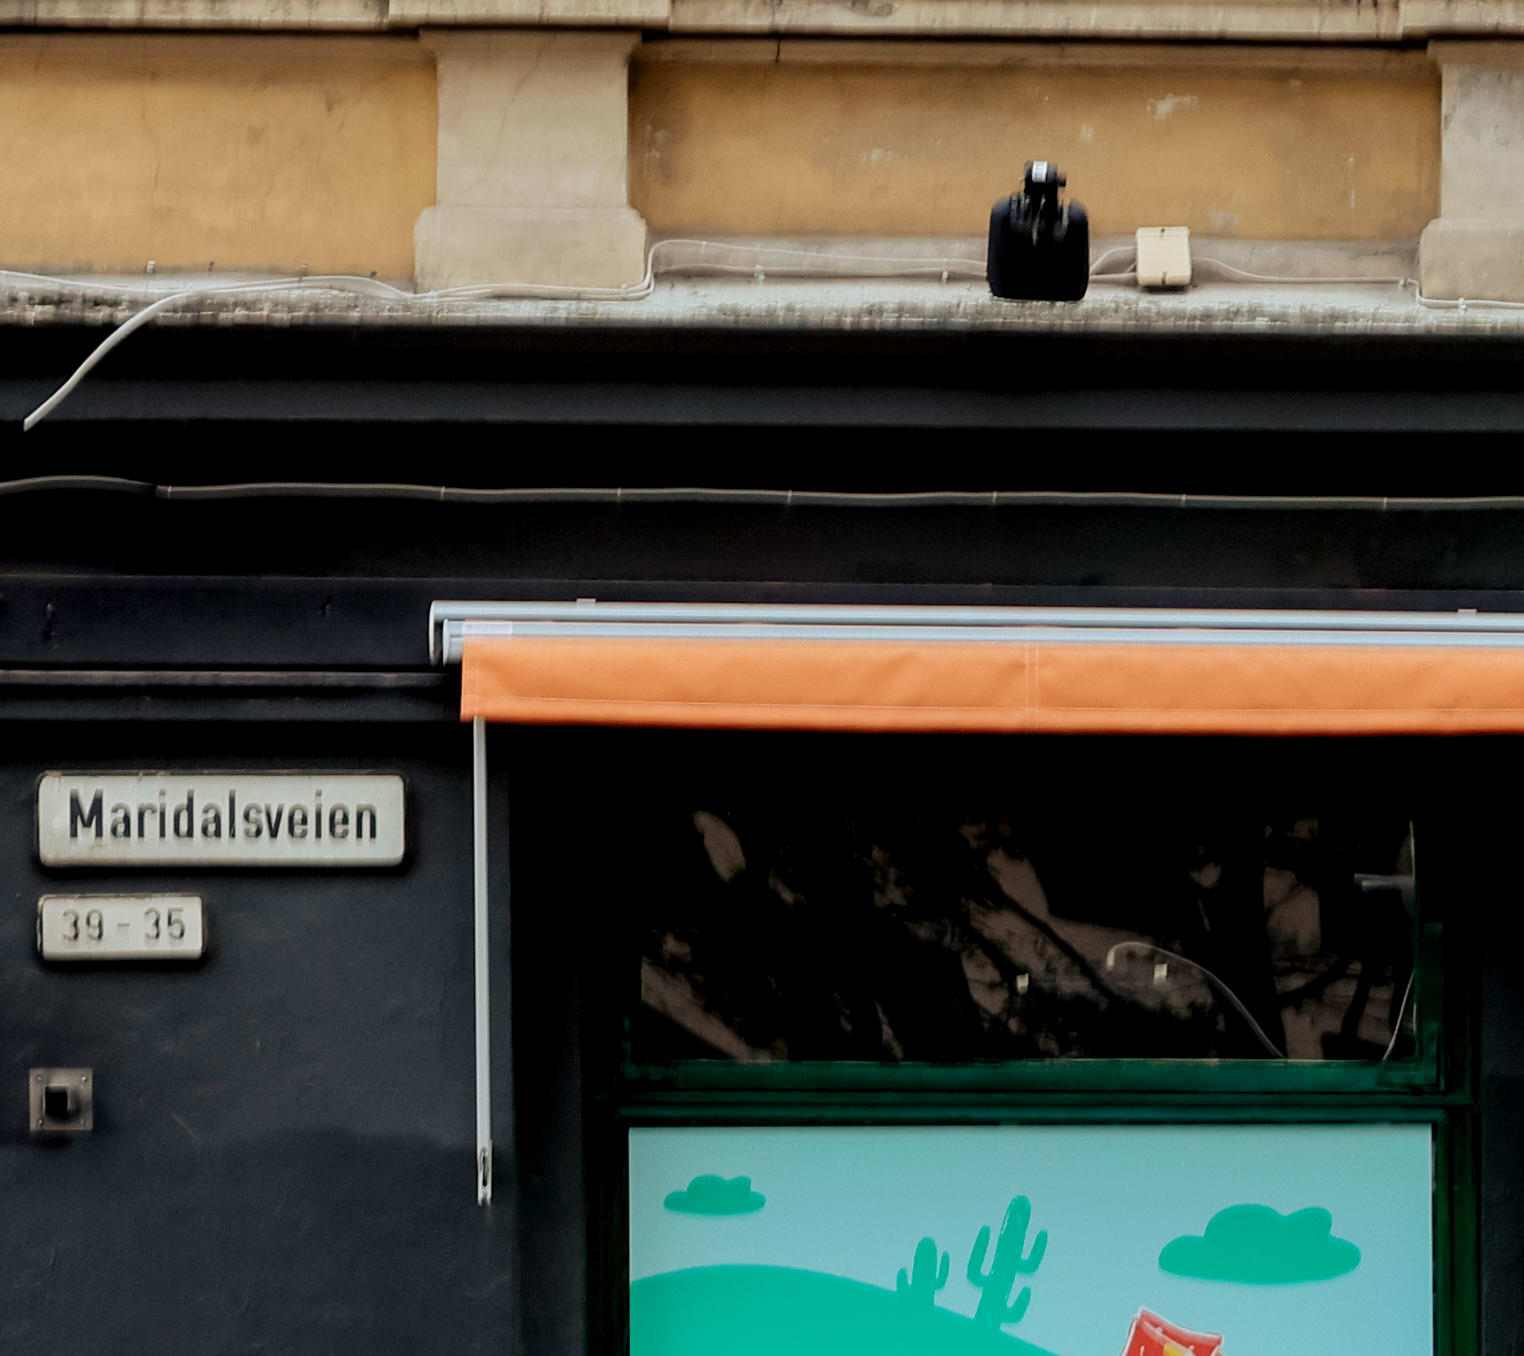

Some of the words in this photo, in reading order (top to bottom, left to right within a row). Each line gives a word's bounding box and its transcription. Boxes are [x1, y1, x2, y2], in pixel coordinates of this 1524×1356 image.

[69, 790, 377, 840] Maridalsveien
[62, 908, 104, 943] 39
[143, 906, 186, 942] 35
